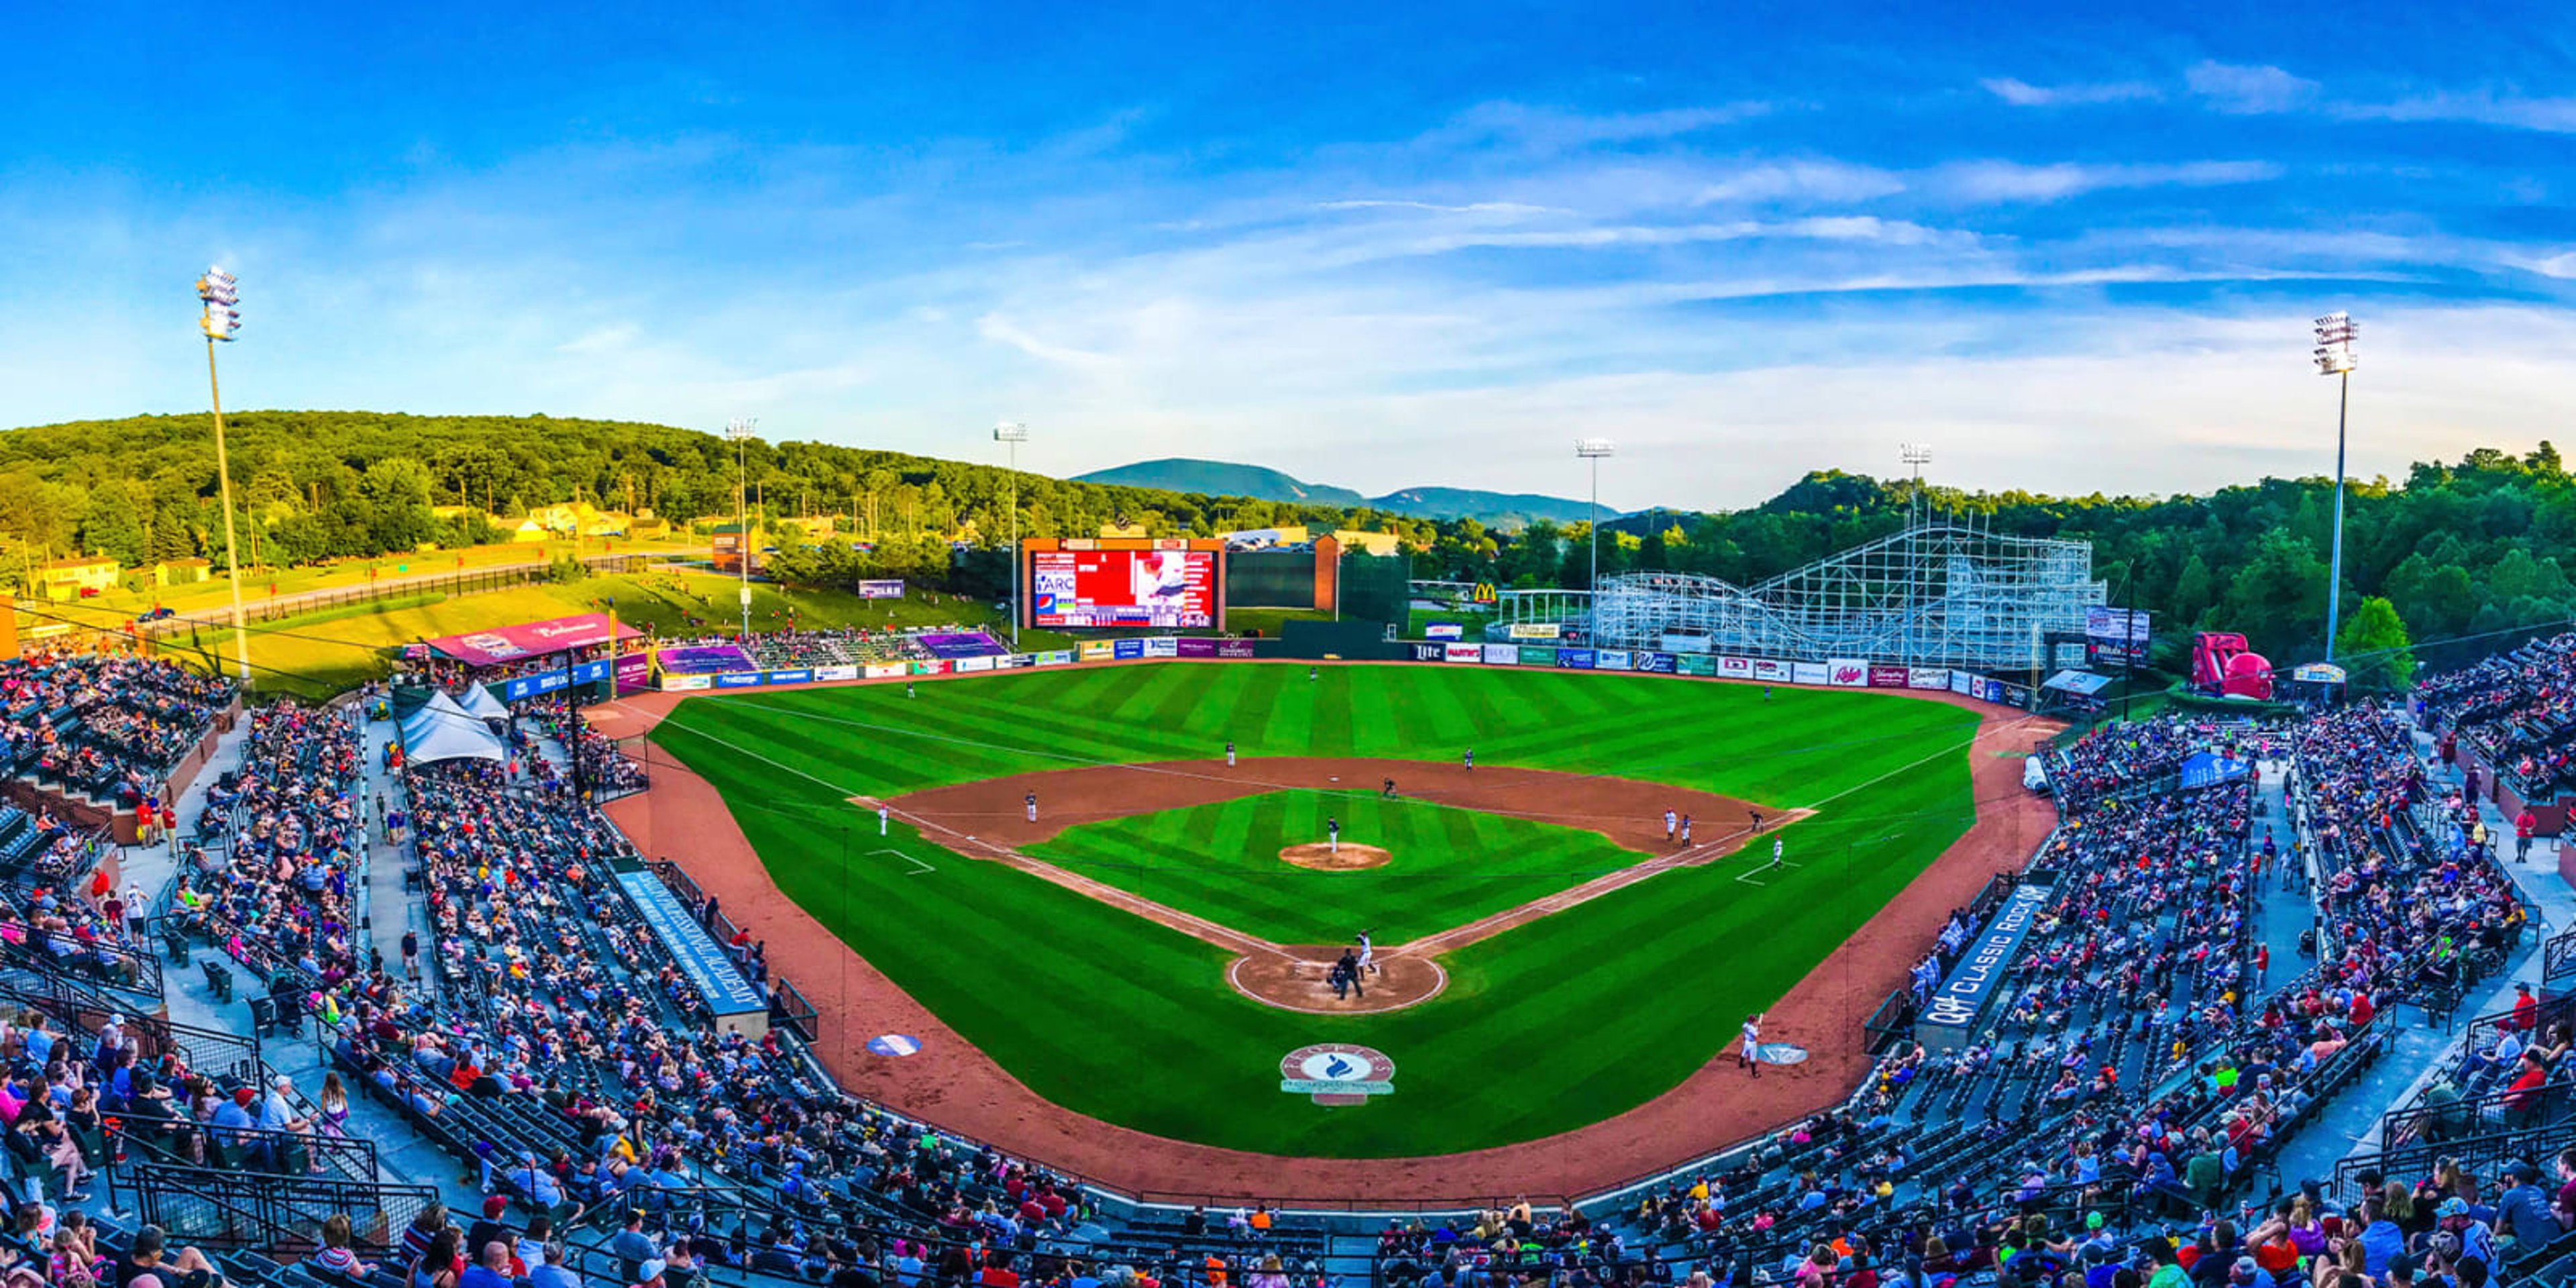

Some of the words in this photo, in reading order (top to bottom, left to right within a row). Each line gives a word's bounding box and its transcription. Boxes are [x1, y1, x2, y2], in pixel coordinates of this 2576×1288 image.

[1417, 645, 1440, 660] Lite
[1995, 900, 2035, 931] ROCK
[1950, 934, 2011, 994] CLASSIC
[701, 955, 764, 1006] ACADEMY
[1927, 994, 1976, 1024] Q94
